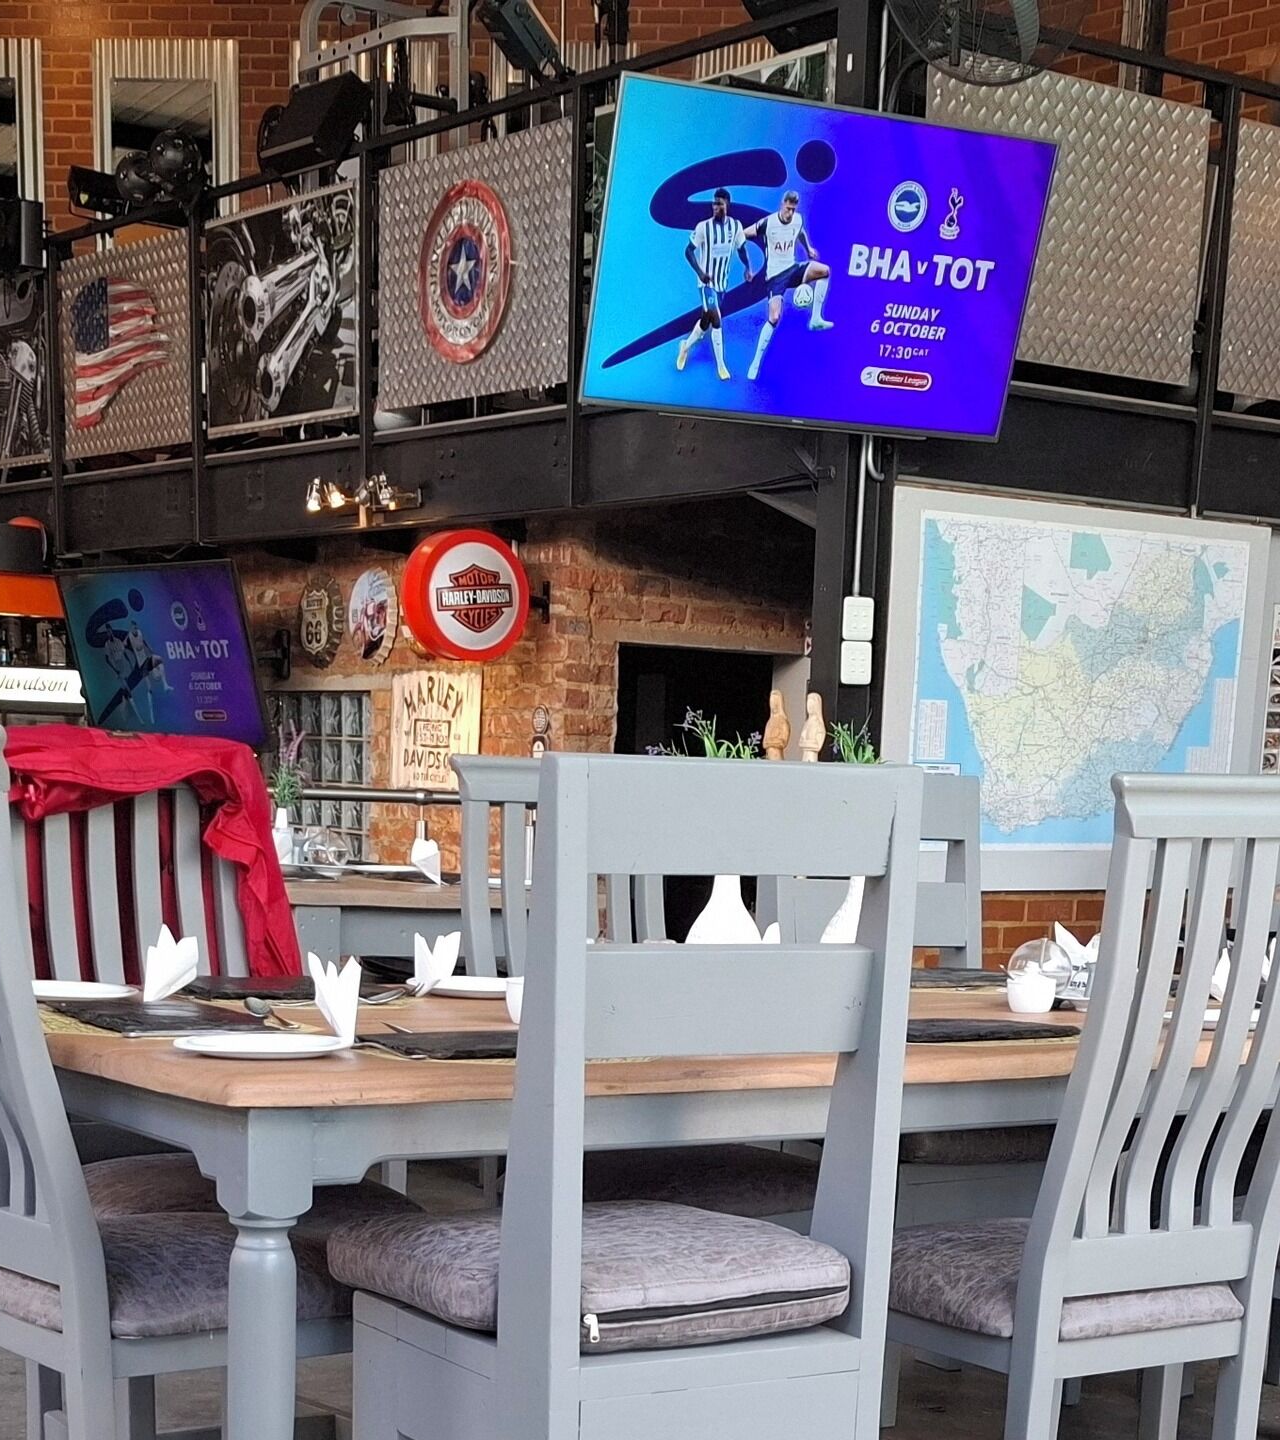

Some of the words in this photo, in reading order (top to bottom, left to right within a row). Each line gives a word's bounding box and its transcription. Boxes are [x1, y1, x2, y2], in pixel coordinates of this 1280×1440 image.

[774, 240, 794, 251] AIA
[848, 243, 911, 283] BHA
[917, 260, 928, 275] v
[932, 254, 995, 291] TOT
[884, 303, 940, 322] SUNDAY
[870, 320, 880, 333] 6
[883, 321, 946, 341] OCTOBER
[878, 373, 903, 383] Premier
[904, 376, 928, 387] League
[458, 572, 496, 586] MOTOR
[442, 588, 509, 606] HARLEY-DAVIDSON
[460, 608, 497, 628] CYCLES
[306, 620, 323, 645] 66
[166, 641, 195, 660] BHA
[200, 640, 229, 659] TOT
[190, 672, 215, 681] SUNDAY
[194, 681, 223, 691] OCTOBER
[403, 748, 450, 769] DAVIDSO
